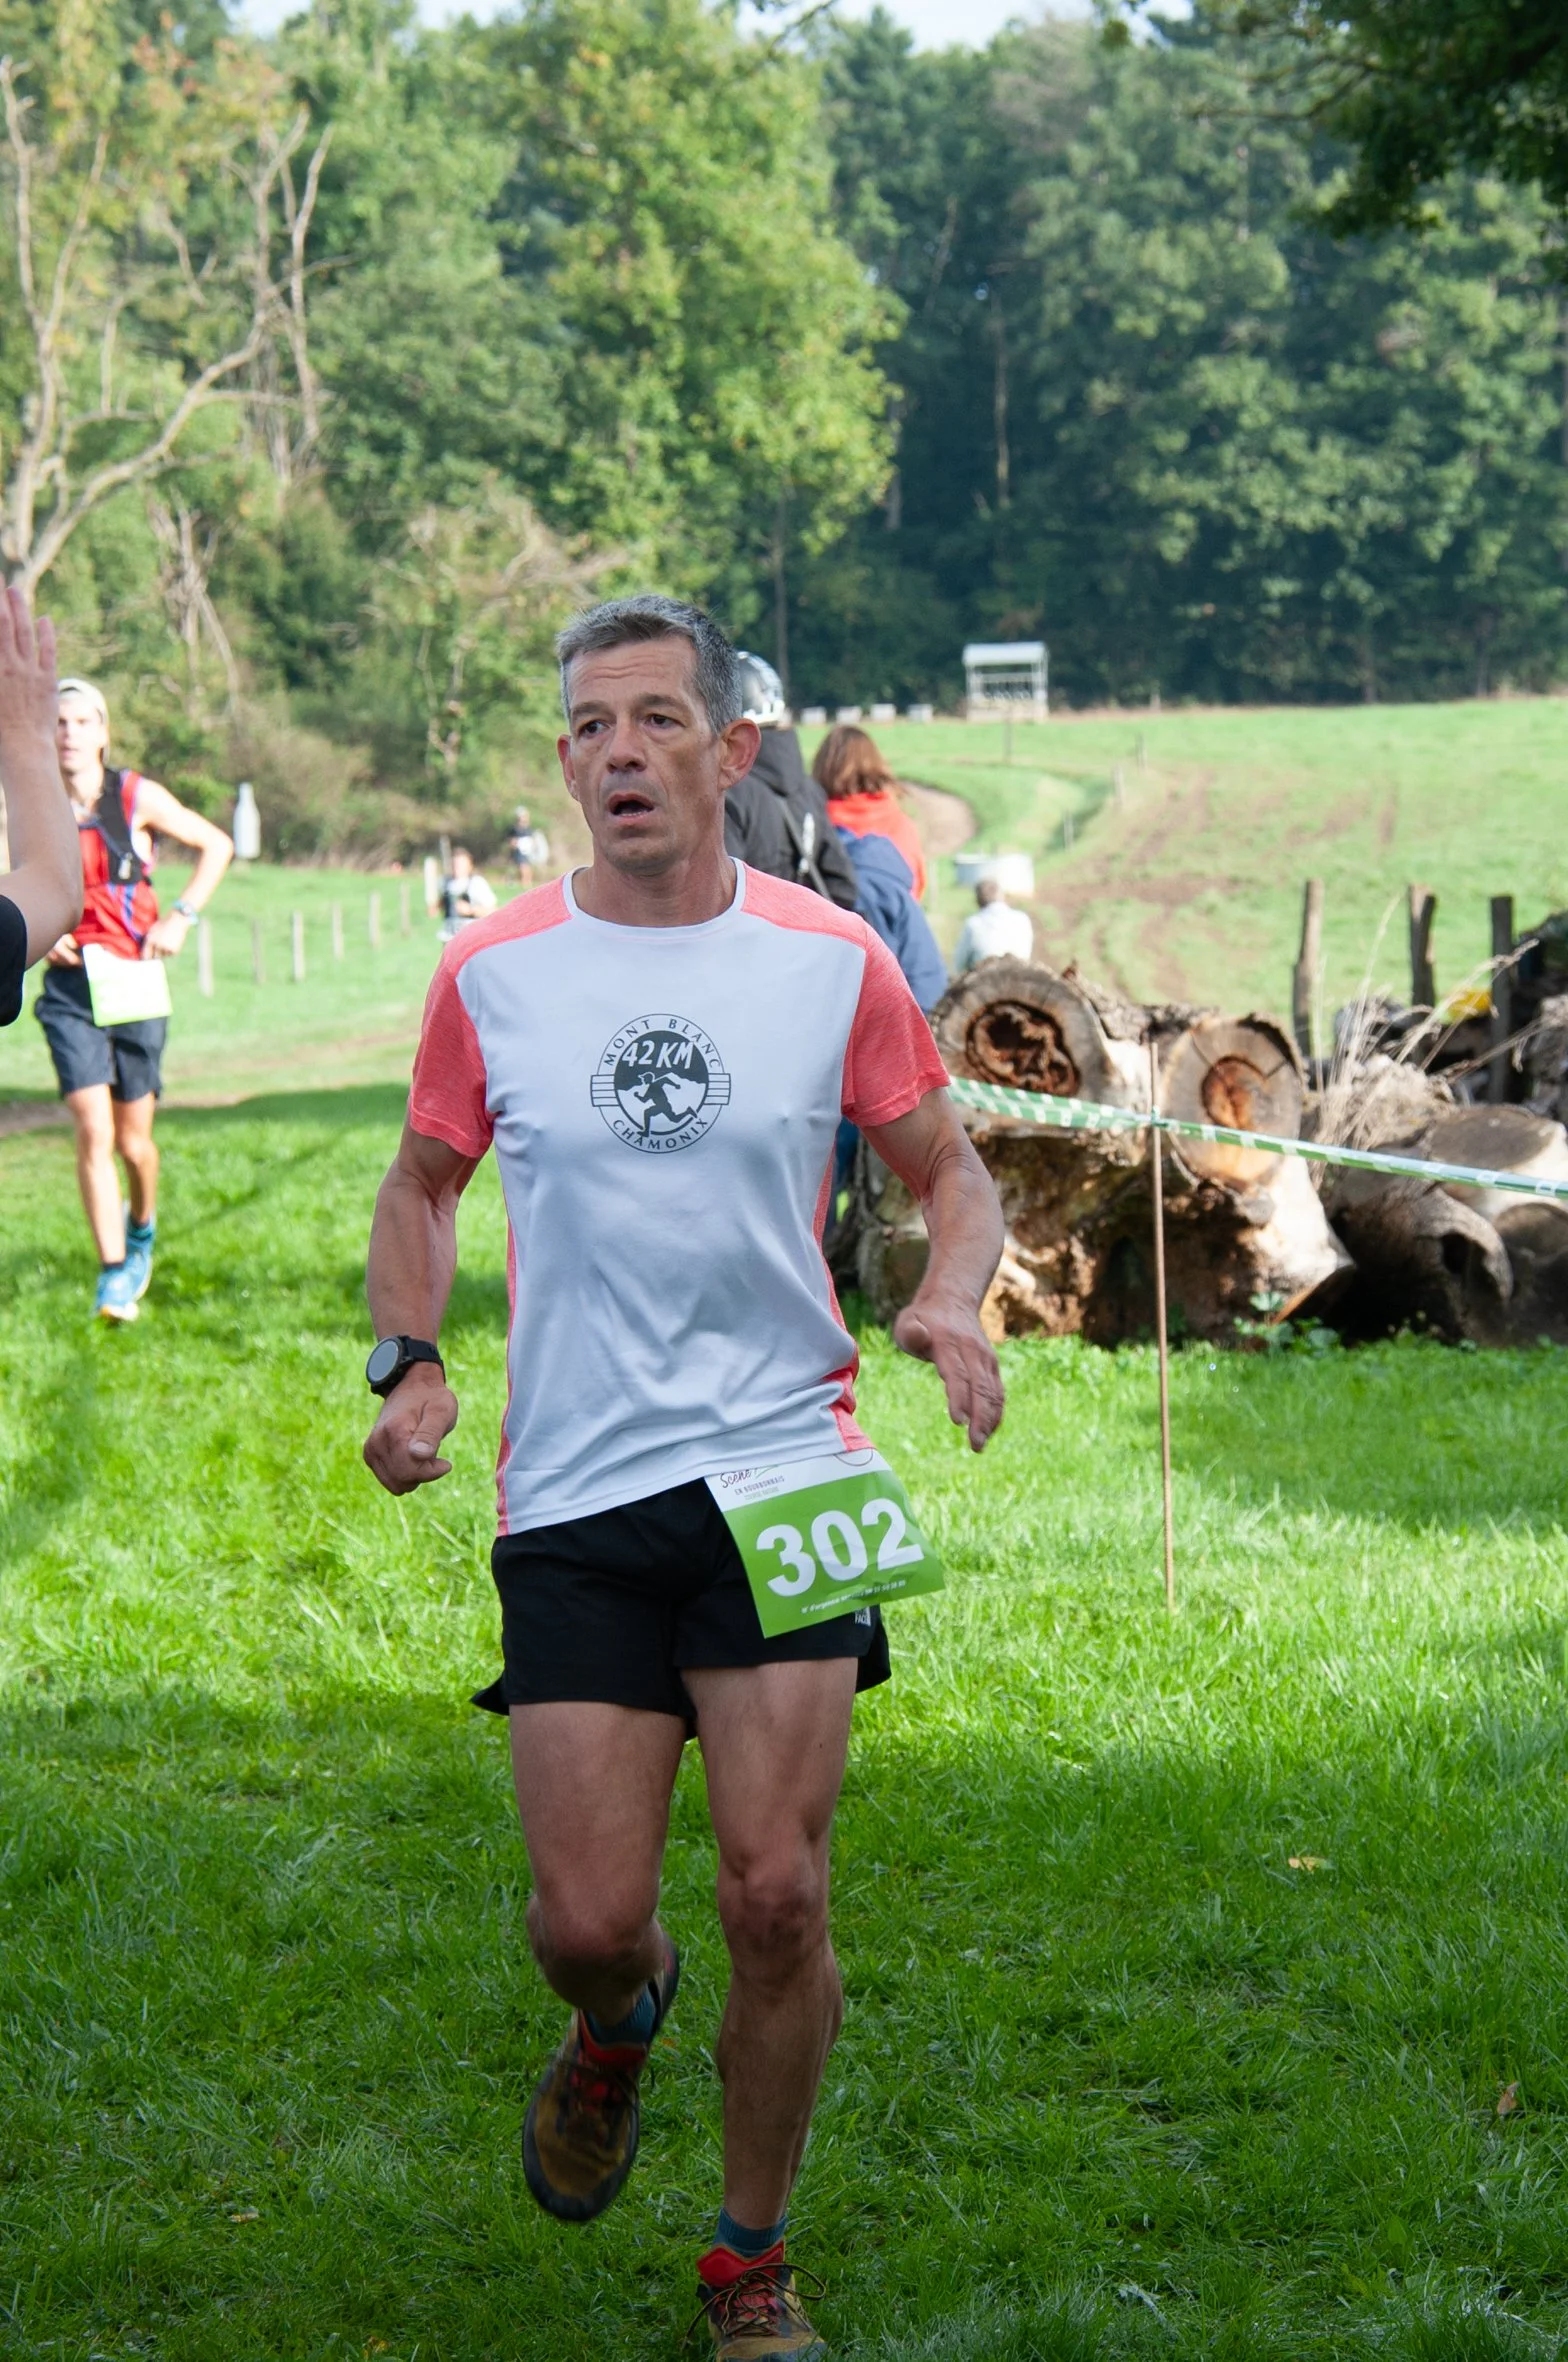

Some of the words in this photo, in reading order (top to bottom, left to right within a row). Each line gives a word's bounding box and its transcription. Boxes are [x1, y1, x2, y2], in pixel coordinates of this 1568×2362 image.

[604, 1019, 651, 1066] MONT
[668, 1018, 721, 1068] BLANC
[613, 1118, 708, 1150] CHAMONIX
[756, 1498, 925, 1597] 302
